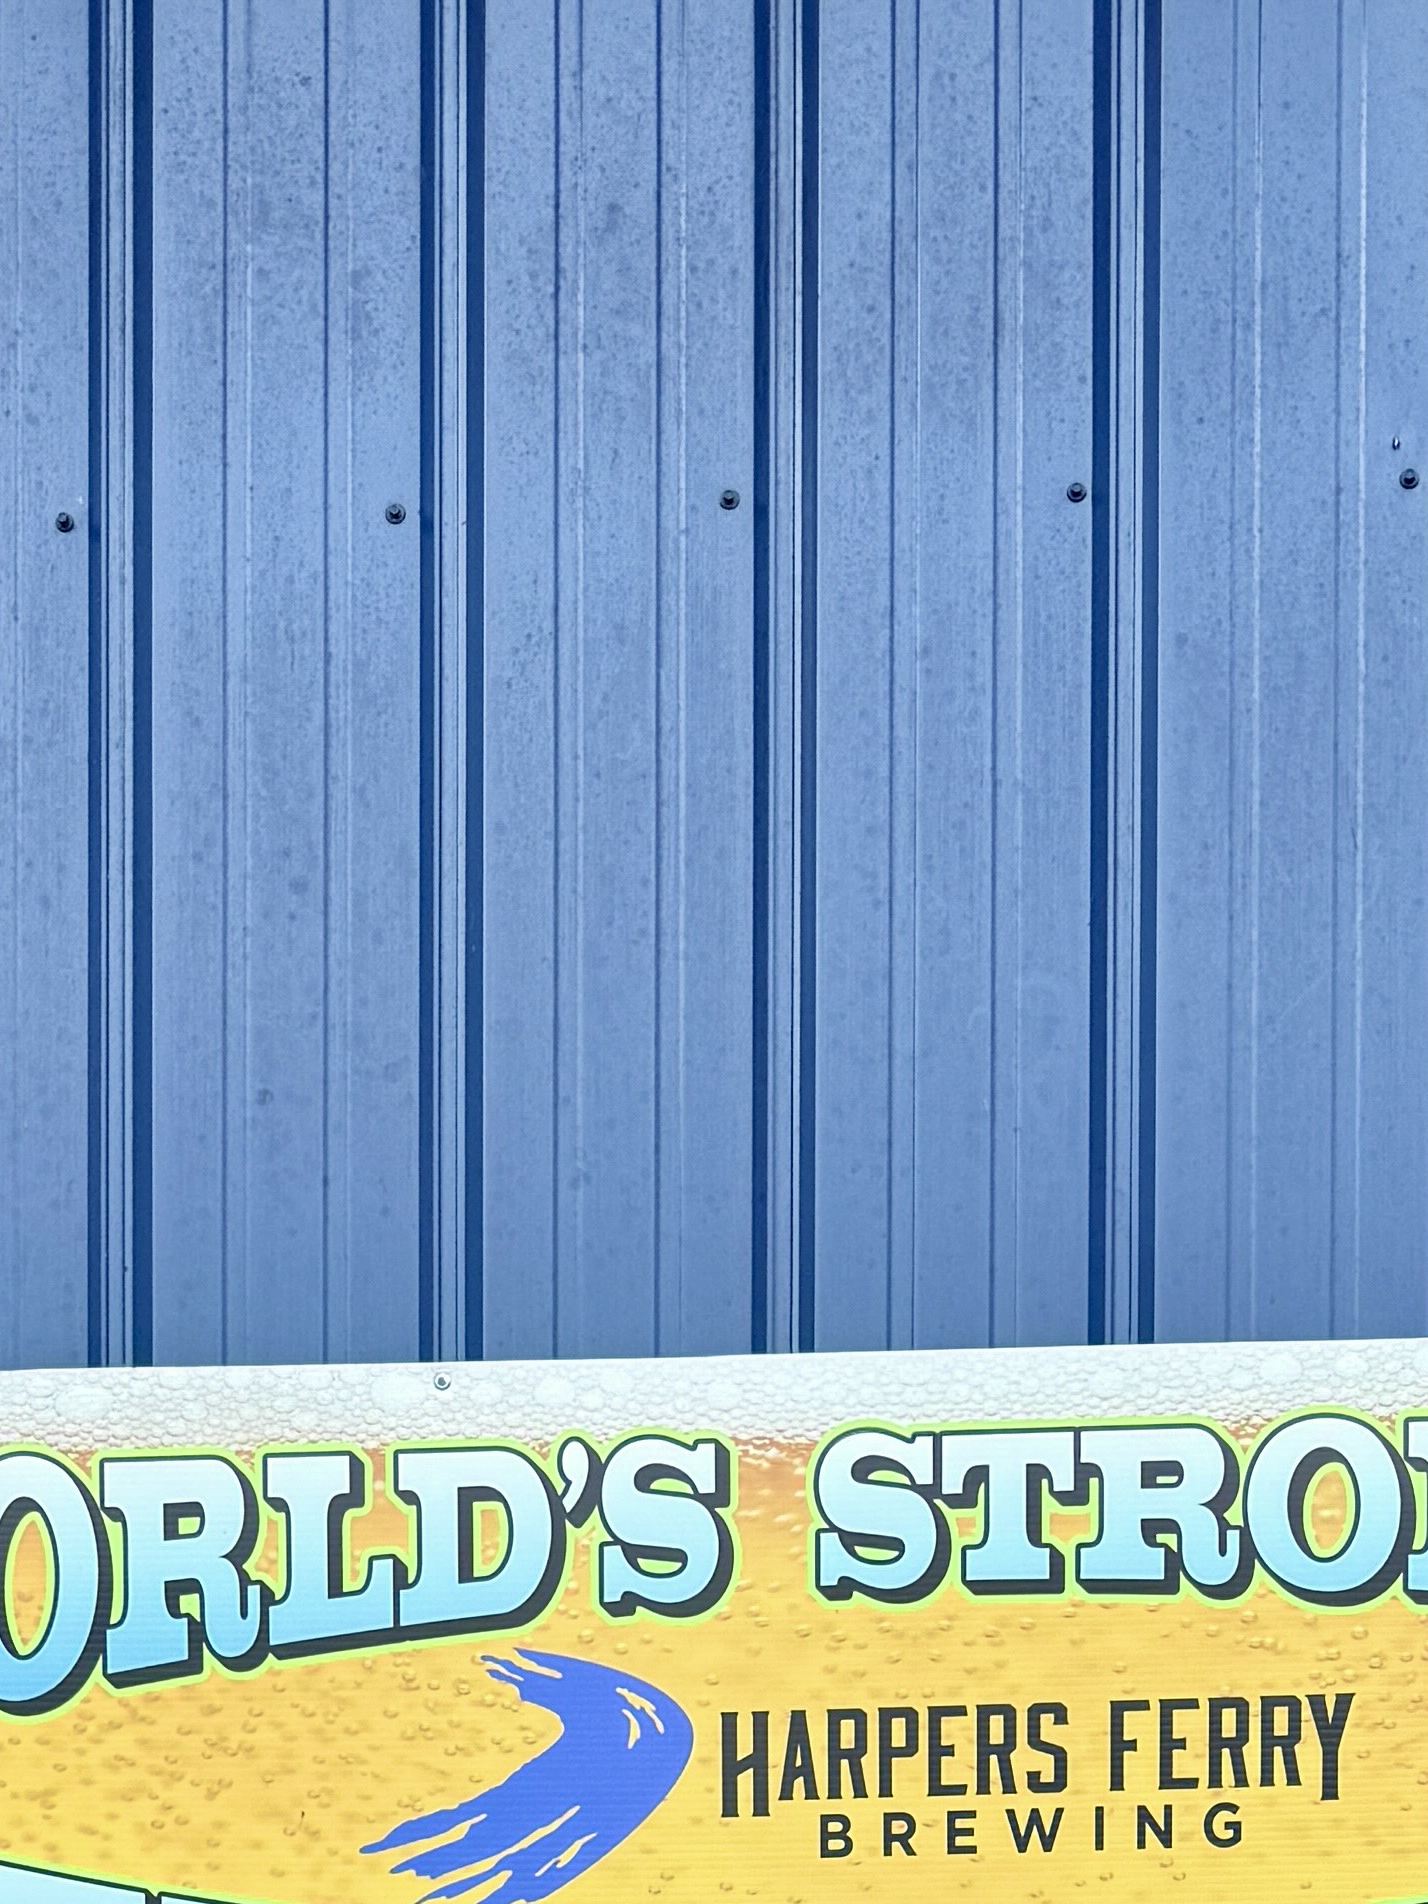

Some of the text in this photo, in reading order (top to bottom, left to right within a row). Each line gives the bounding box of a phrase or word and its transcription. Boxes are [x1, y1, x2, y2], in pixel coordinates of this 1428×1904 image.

[720, 1692, 1356, 1818] HARPERS FERRY
[818, 1801, 1243, 1859] BREWING
